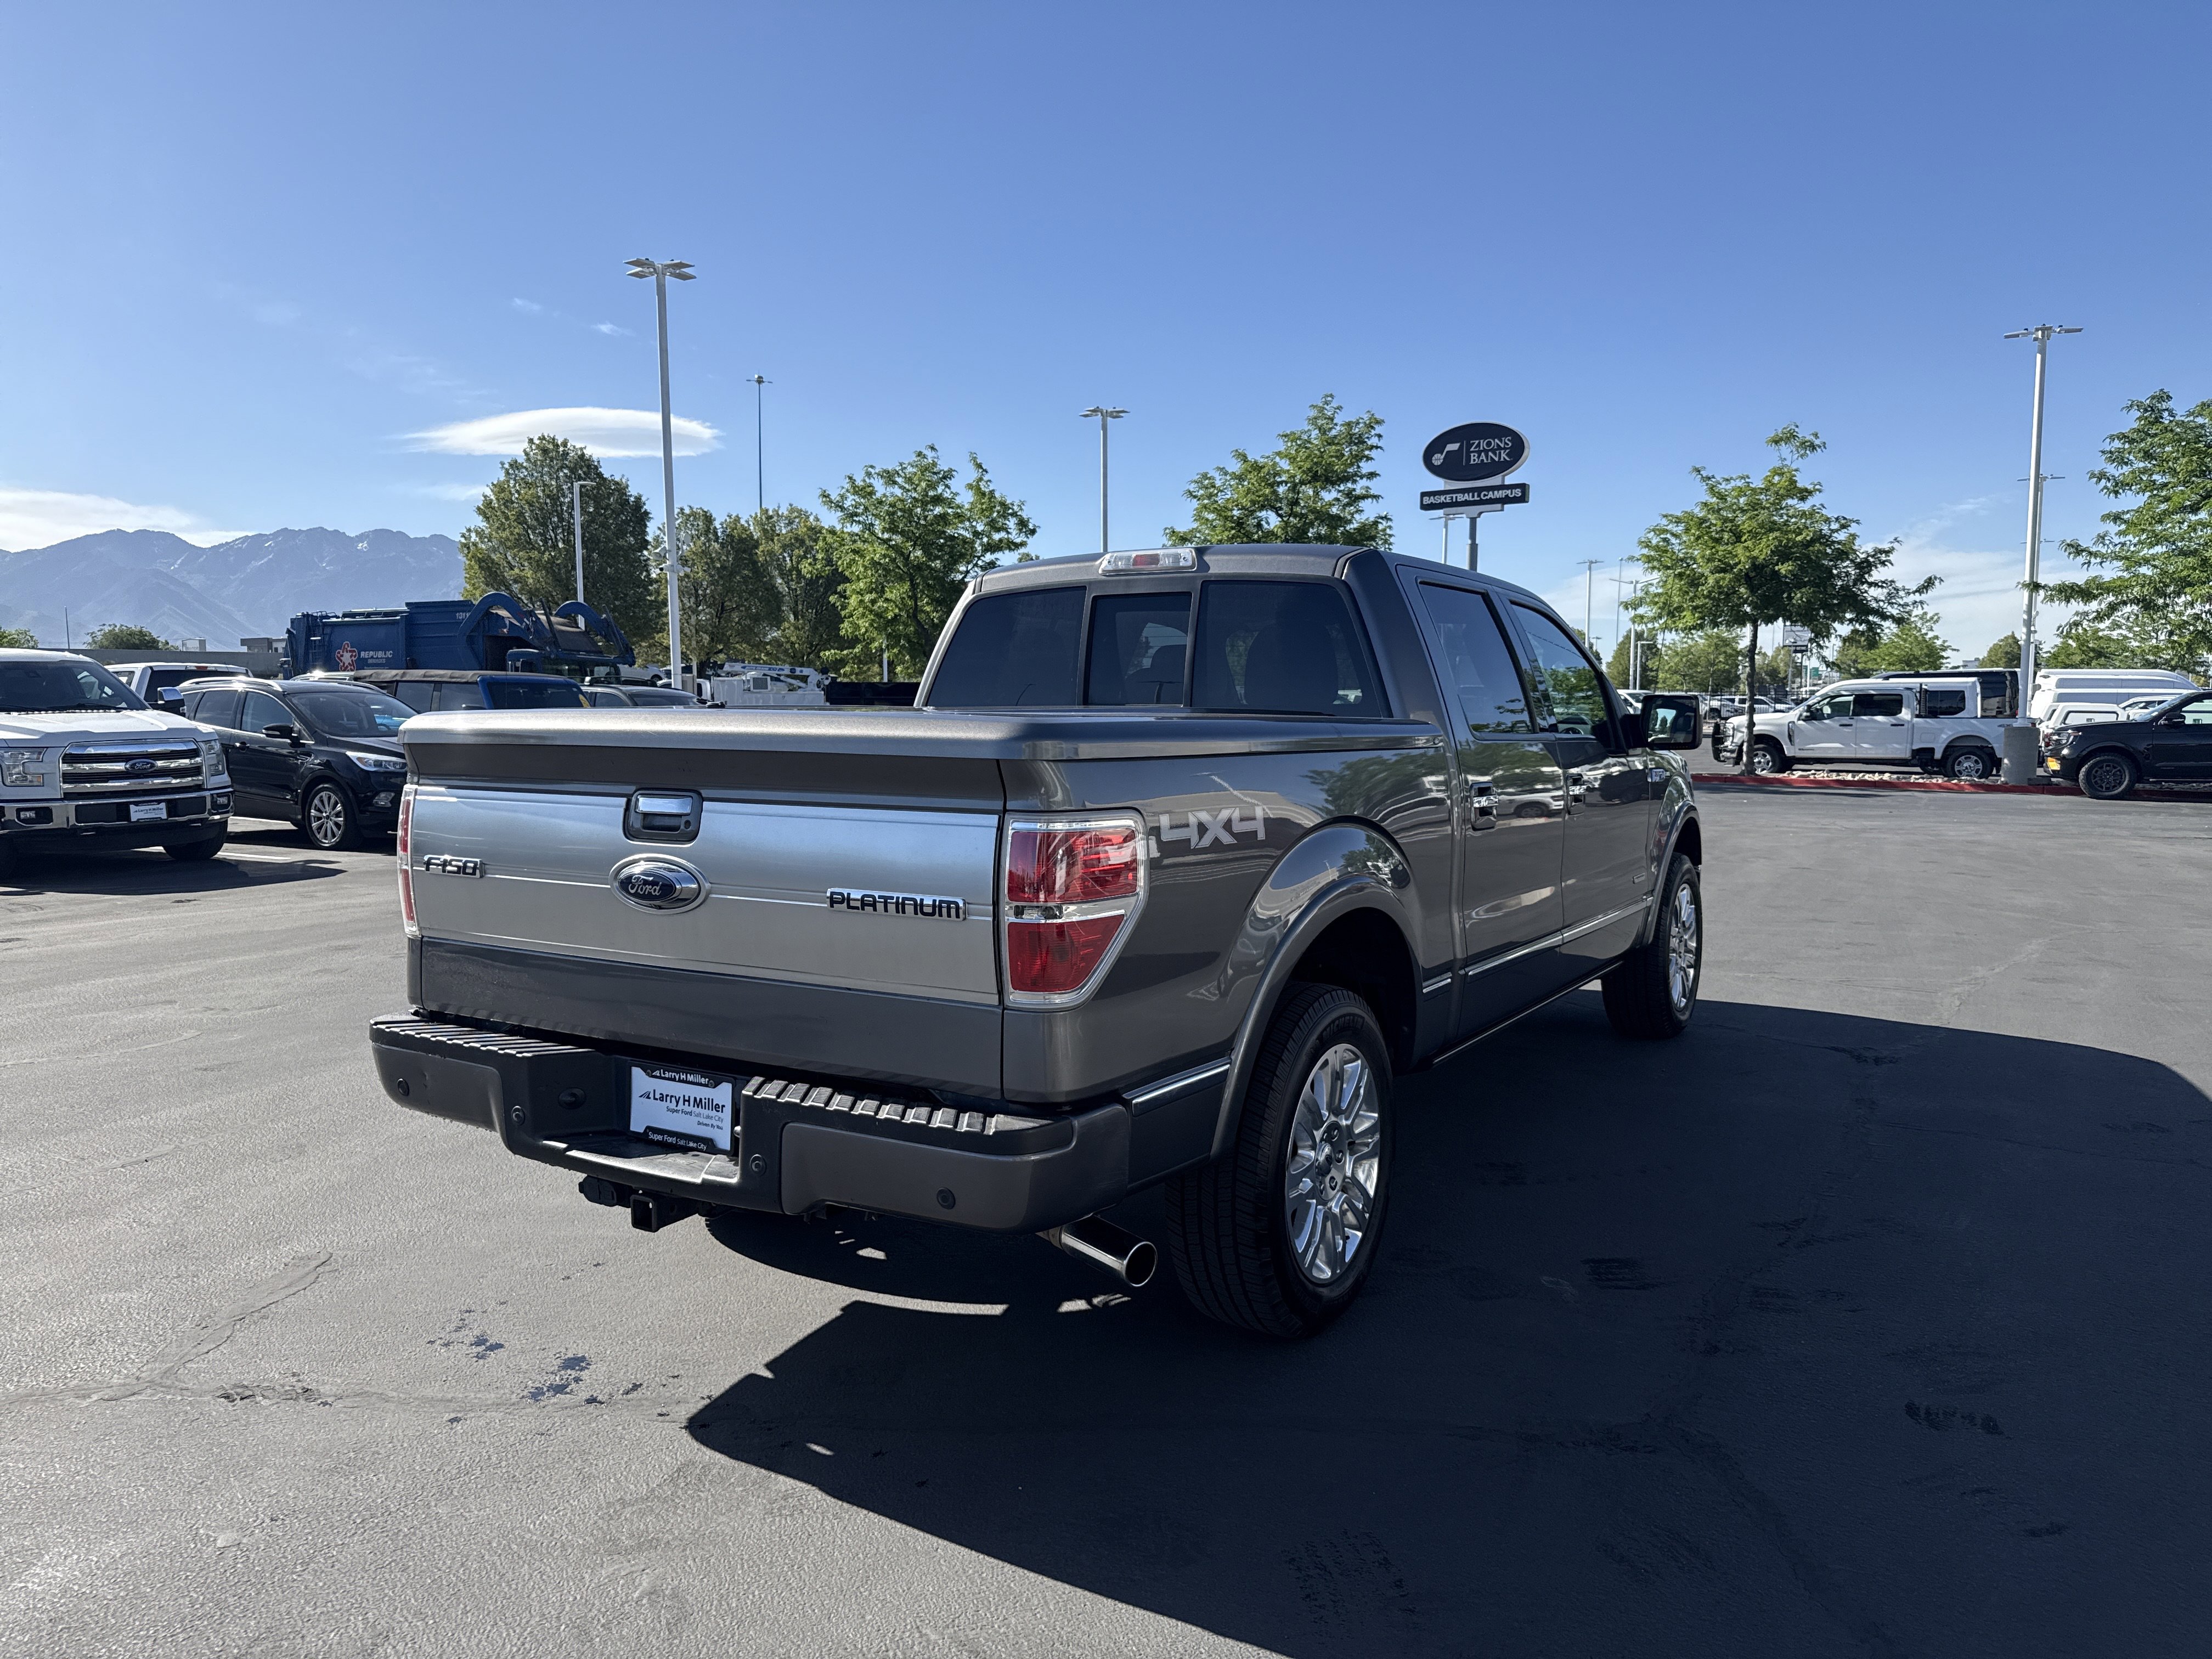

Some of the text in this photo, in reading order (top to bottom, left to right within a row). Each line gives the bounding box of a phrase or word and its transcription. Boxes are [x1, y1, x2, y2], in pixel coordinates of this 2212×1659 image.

[1470, 437, 1511, 452] ZIONS
[1469, 449, 1510, 465] BANK
[1423, 488, 1522, 505] BASKETBALL CAMPUS
[629, 874, 662, 896] Ford
[830, 891, 961, 918] PLATINUM
[1322, 1014, 1364, 1041] MICHELIN
[661, 1069, 709, 1085] Larry H Miller
[653, 1089, 726, 1113] Larry H Miller
[666, 1106, 680, 1114] Super
[714, 1115, 724, 1124] City
[648, 1132, 663, 1141] Super
[664, 1135, 676, 1144] Ford
[697, 1142, 707, 1152] City
